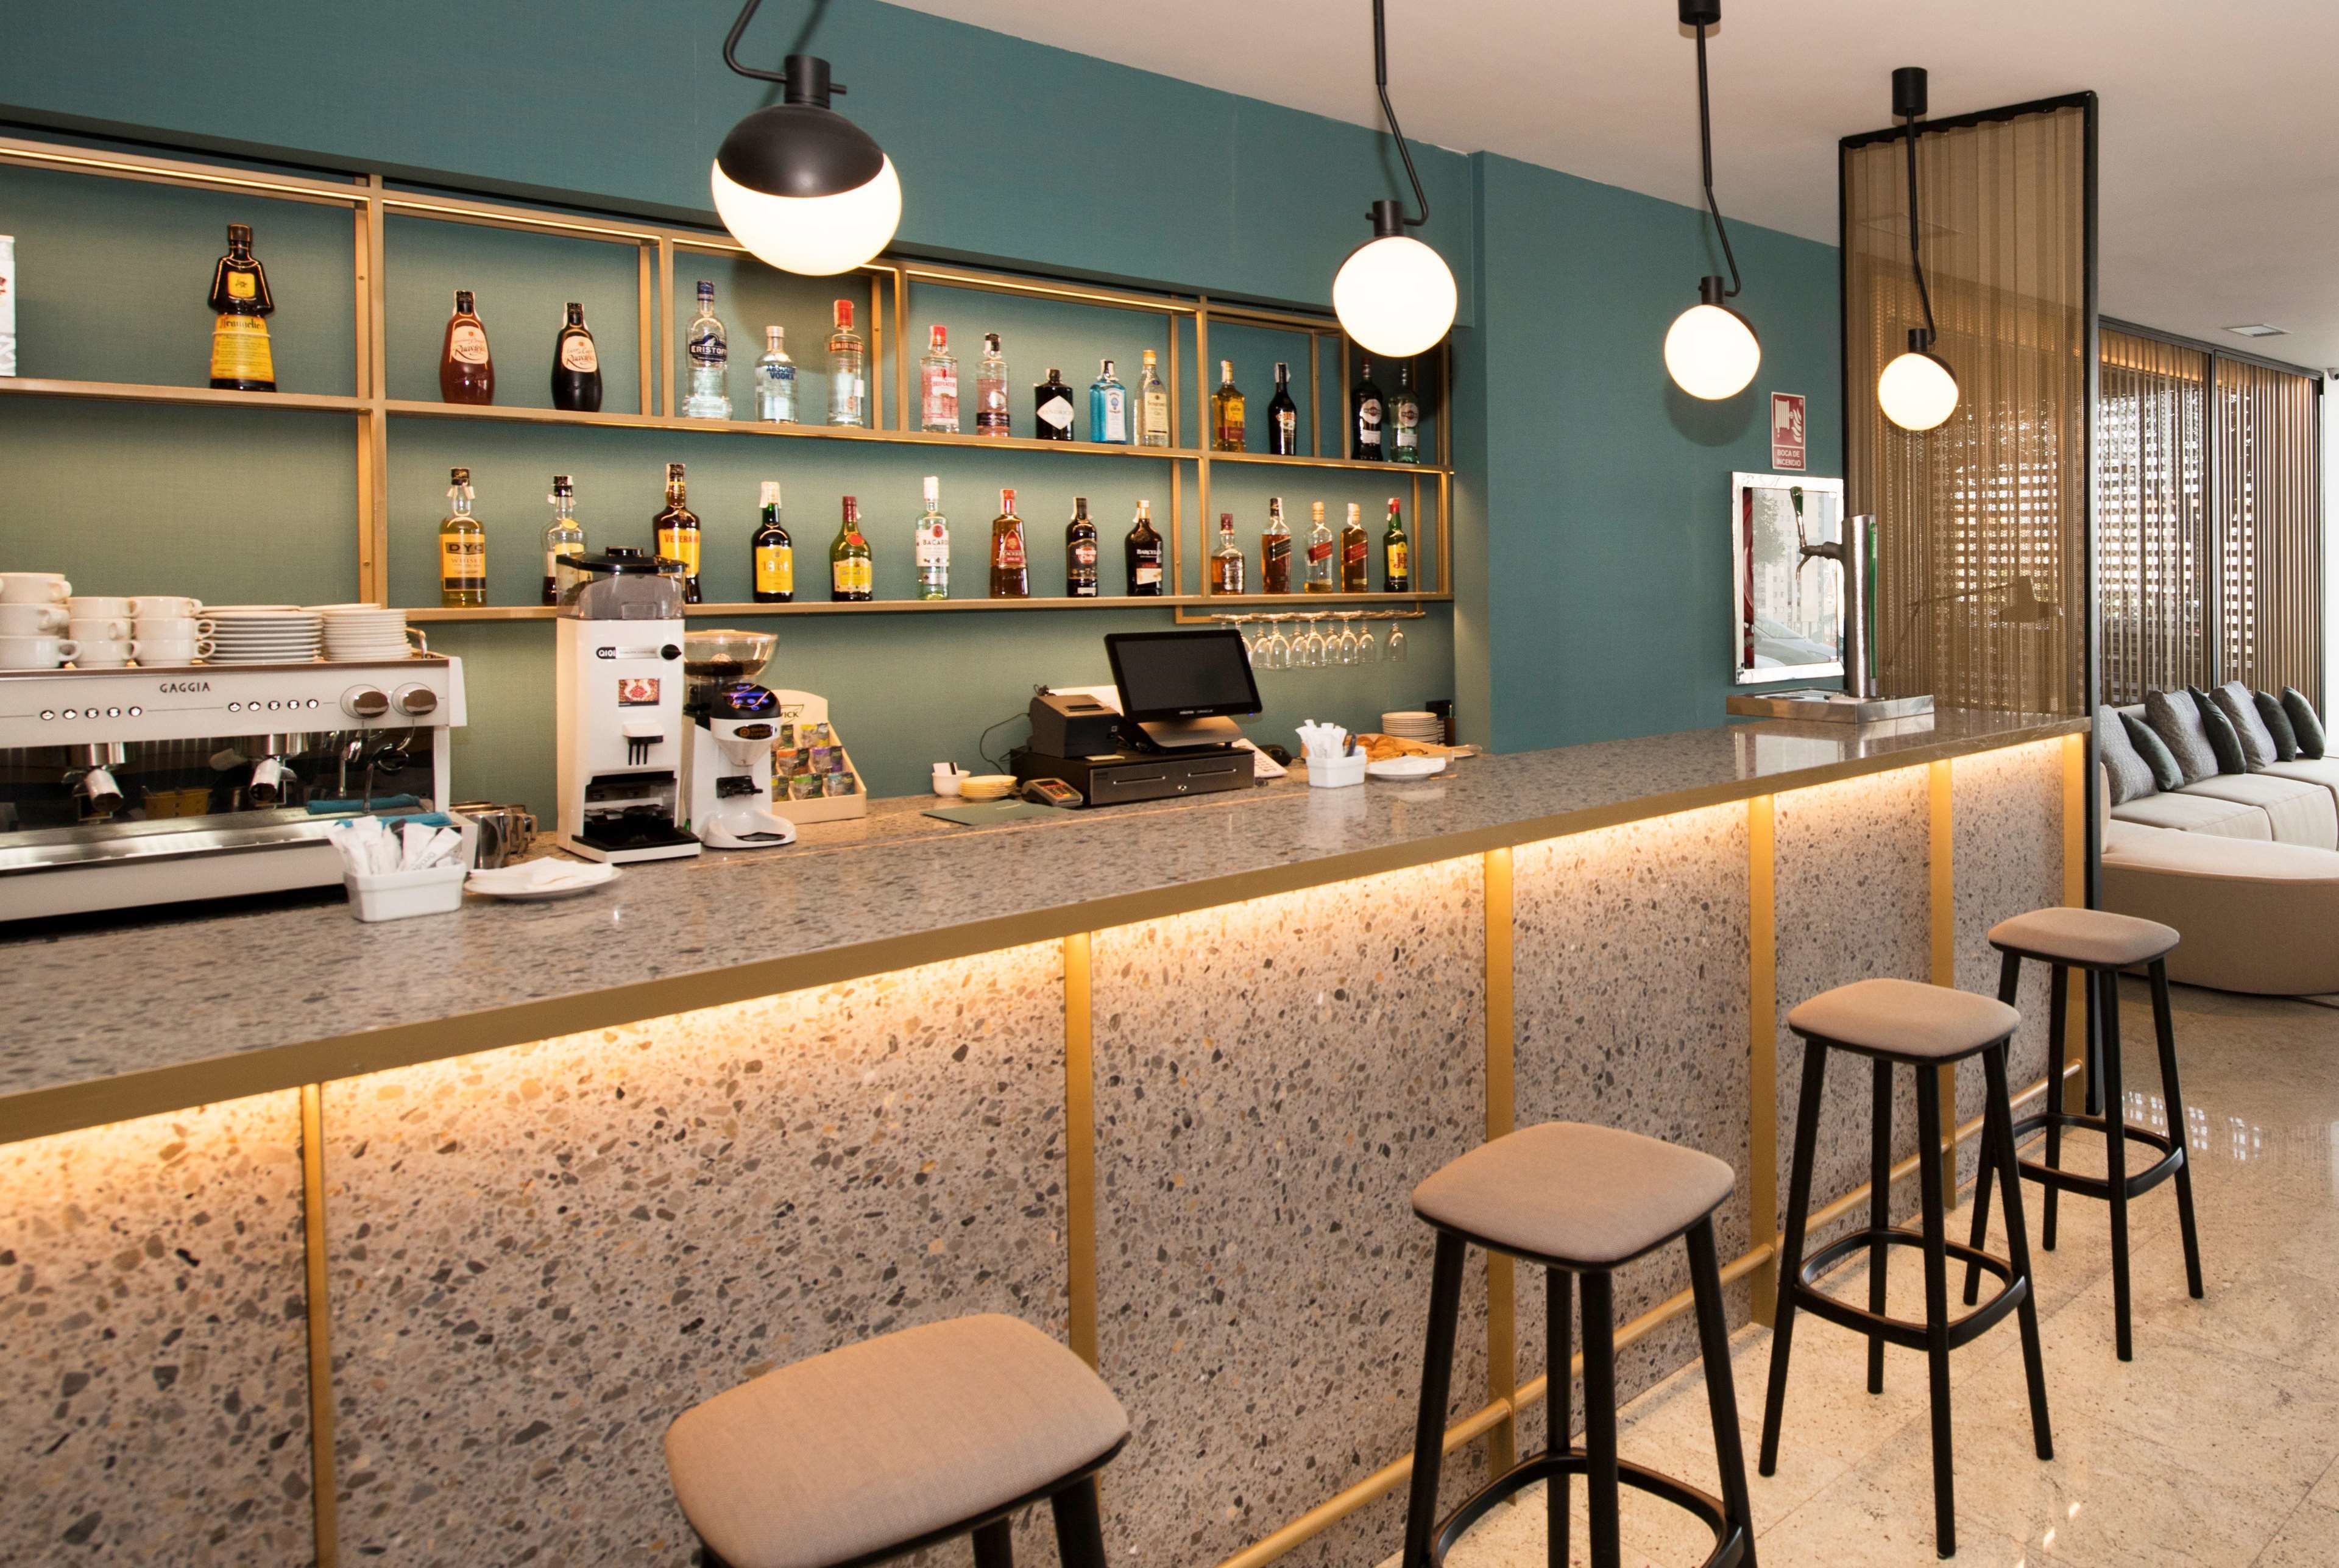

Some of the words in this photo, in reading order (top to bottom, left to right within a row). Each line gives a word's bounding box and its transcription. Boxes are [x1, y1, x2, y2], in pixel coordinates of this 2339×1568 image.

[770, 372, 794, 380] VODKA
[1776, 458, 1802, 467] INCENDIO
[159, 682, 210, 693] GAGGIA
